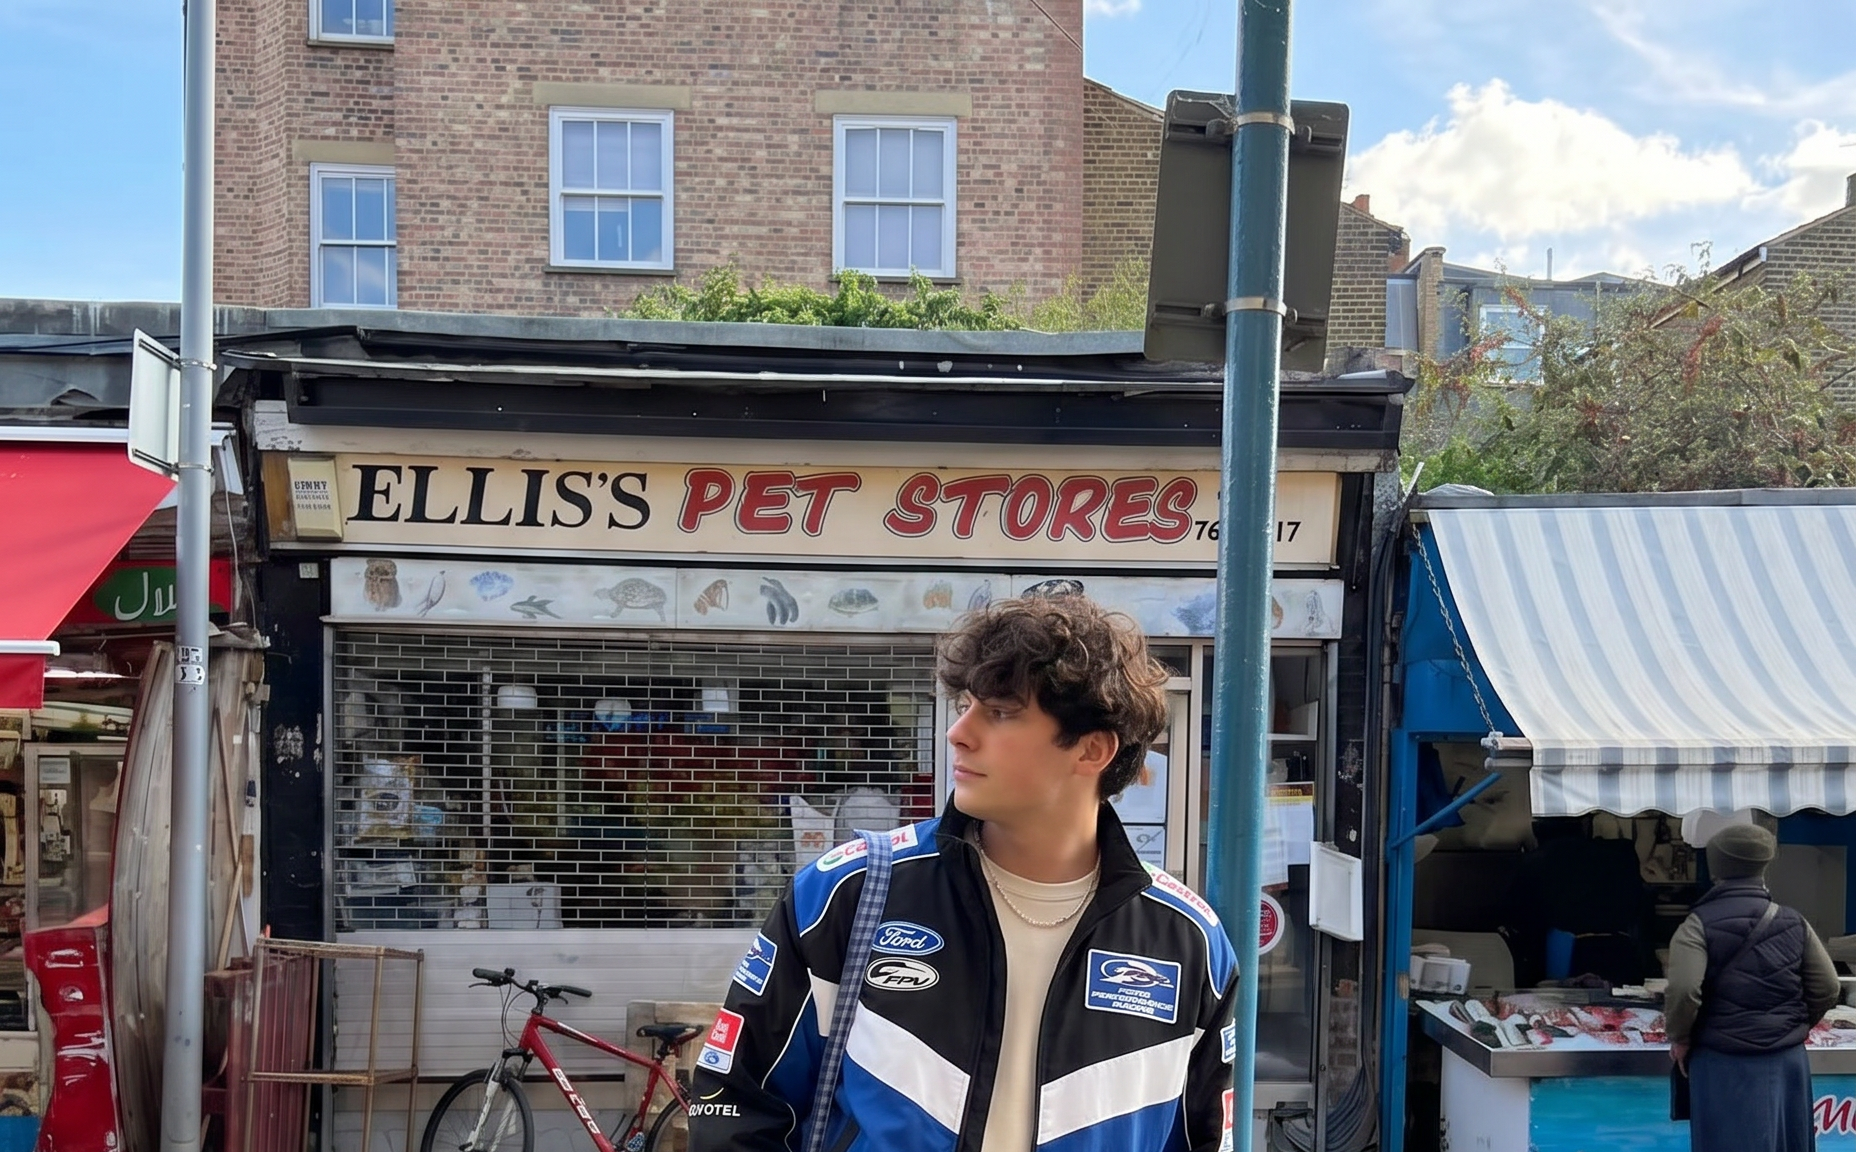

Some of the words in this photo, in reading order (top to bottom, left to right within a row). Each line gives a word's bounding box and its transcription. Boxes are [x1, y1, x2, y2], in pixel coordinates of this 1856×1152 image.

[346, 464, 652, 531] ELLIS'S
[677, 467, 862, 537] PET
[883, 472, 1198, 544] STORES
[1194, 520, 1220, 540] 76
[1276, 521, 1302, 543] 17
[844, 831, 909, 856] Caol
[879, 926, 927, 949] Ford
[882, 975, 930, 986] FPV
